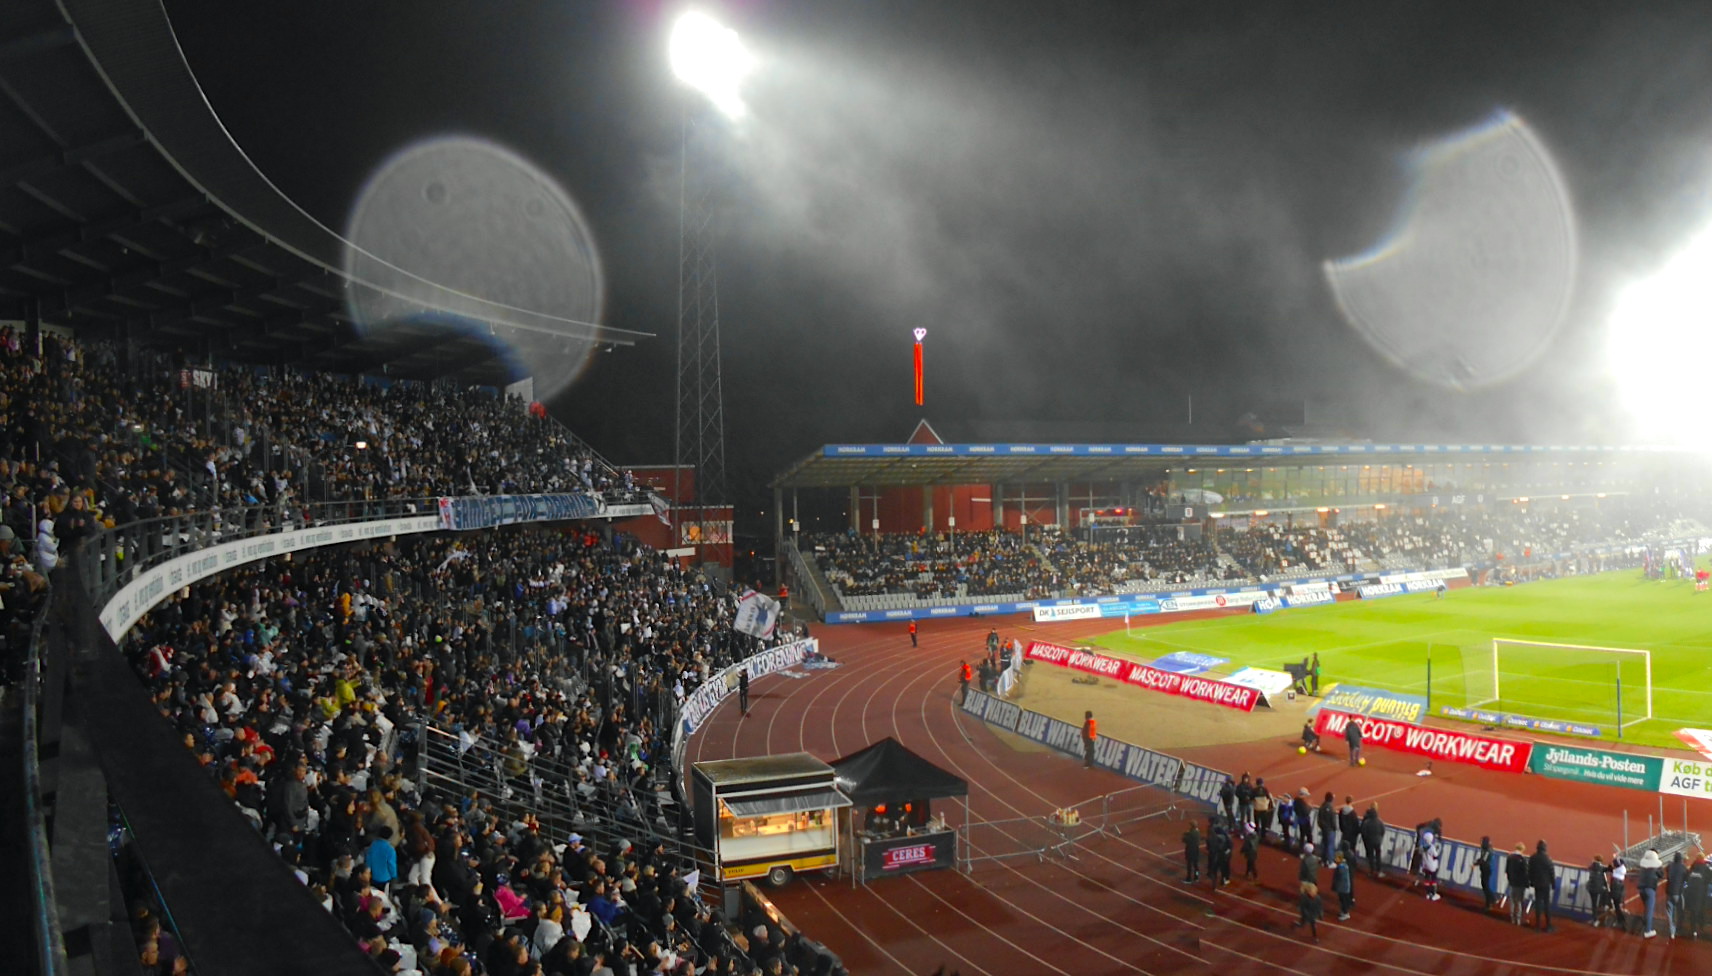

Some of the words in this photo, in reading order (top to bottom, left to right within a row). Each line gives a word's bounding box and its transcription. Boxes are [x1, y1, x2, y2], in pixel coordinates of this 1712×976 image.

[1069, 650, 1121, 674] WORKWEAR
[1181, 678, 1250, 707] WORKWEAR
[964, 689, 985, 716] BLUE
[985, 696, 1018, 731] WATER
[1019, 709, 1047, 741] BLUE
[1406, 727, 1515, 766] WORKWEAR
[1125, 746, 1179, 788] WATER
[1545, 748, 1646, 774] Jyllands-Posten
[1673, 760, 1701, 777] Køb
[1670, 777, 1702, 790] AGF
[892, 846, 926, 863] CERES
